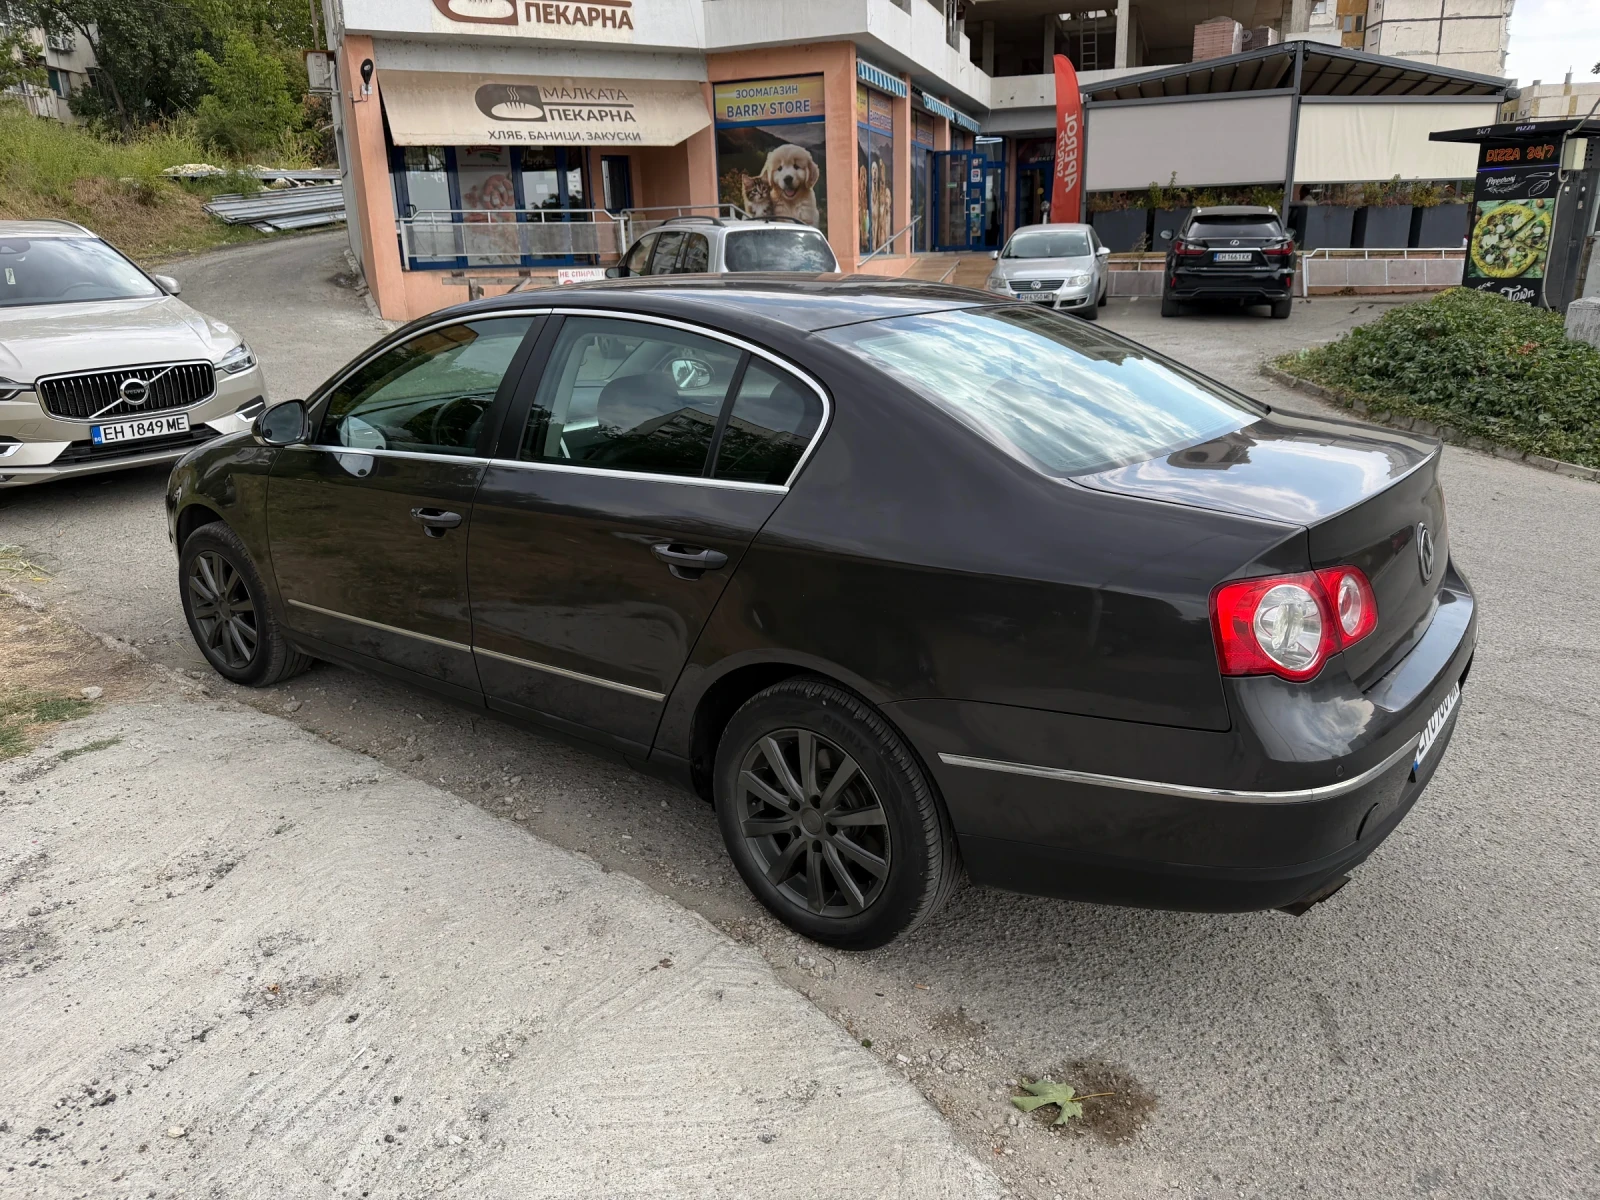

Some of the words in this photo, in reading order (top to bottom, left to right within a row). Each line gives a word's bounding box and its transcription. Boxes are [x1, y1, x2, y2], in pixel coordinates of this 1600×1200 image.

[525, 1, 634, 30] ПЕКАРНА
[542, 86, 629, 101] МАЛКАТА
[735, 84, 798, 99] ЗООМАГАЗИН
[548, 109, 637, 122] ПЕКАРНА
[726, 103, 767, 118] BARRY
[769, 99, 811, 115] STORE
[487, 130, 526, 141] ХЛЯБ,
[529, 131, 585, 142] БАНИЦИ,
[587, 131, 642, 141] ЗАКУСКИ
[1500, 285, 1535, 301] Town
[103, 425, 125, 441] EH
[129, 422, 164, 437] 1849
[167, 417, 187, 432] ME
